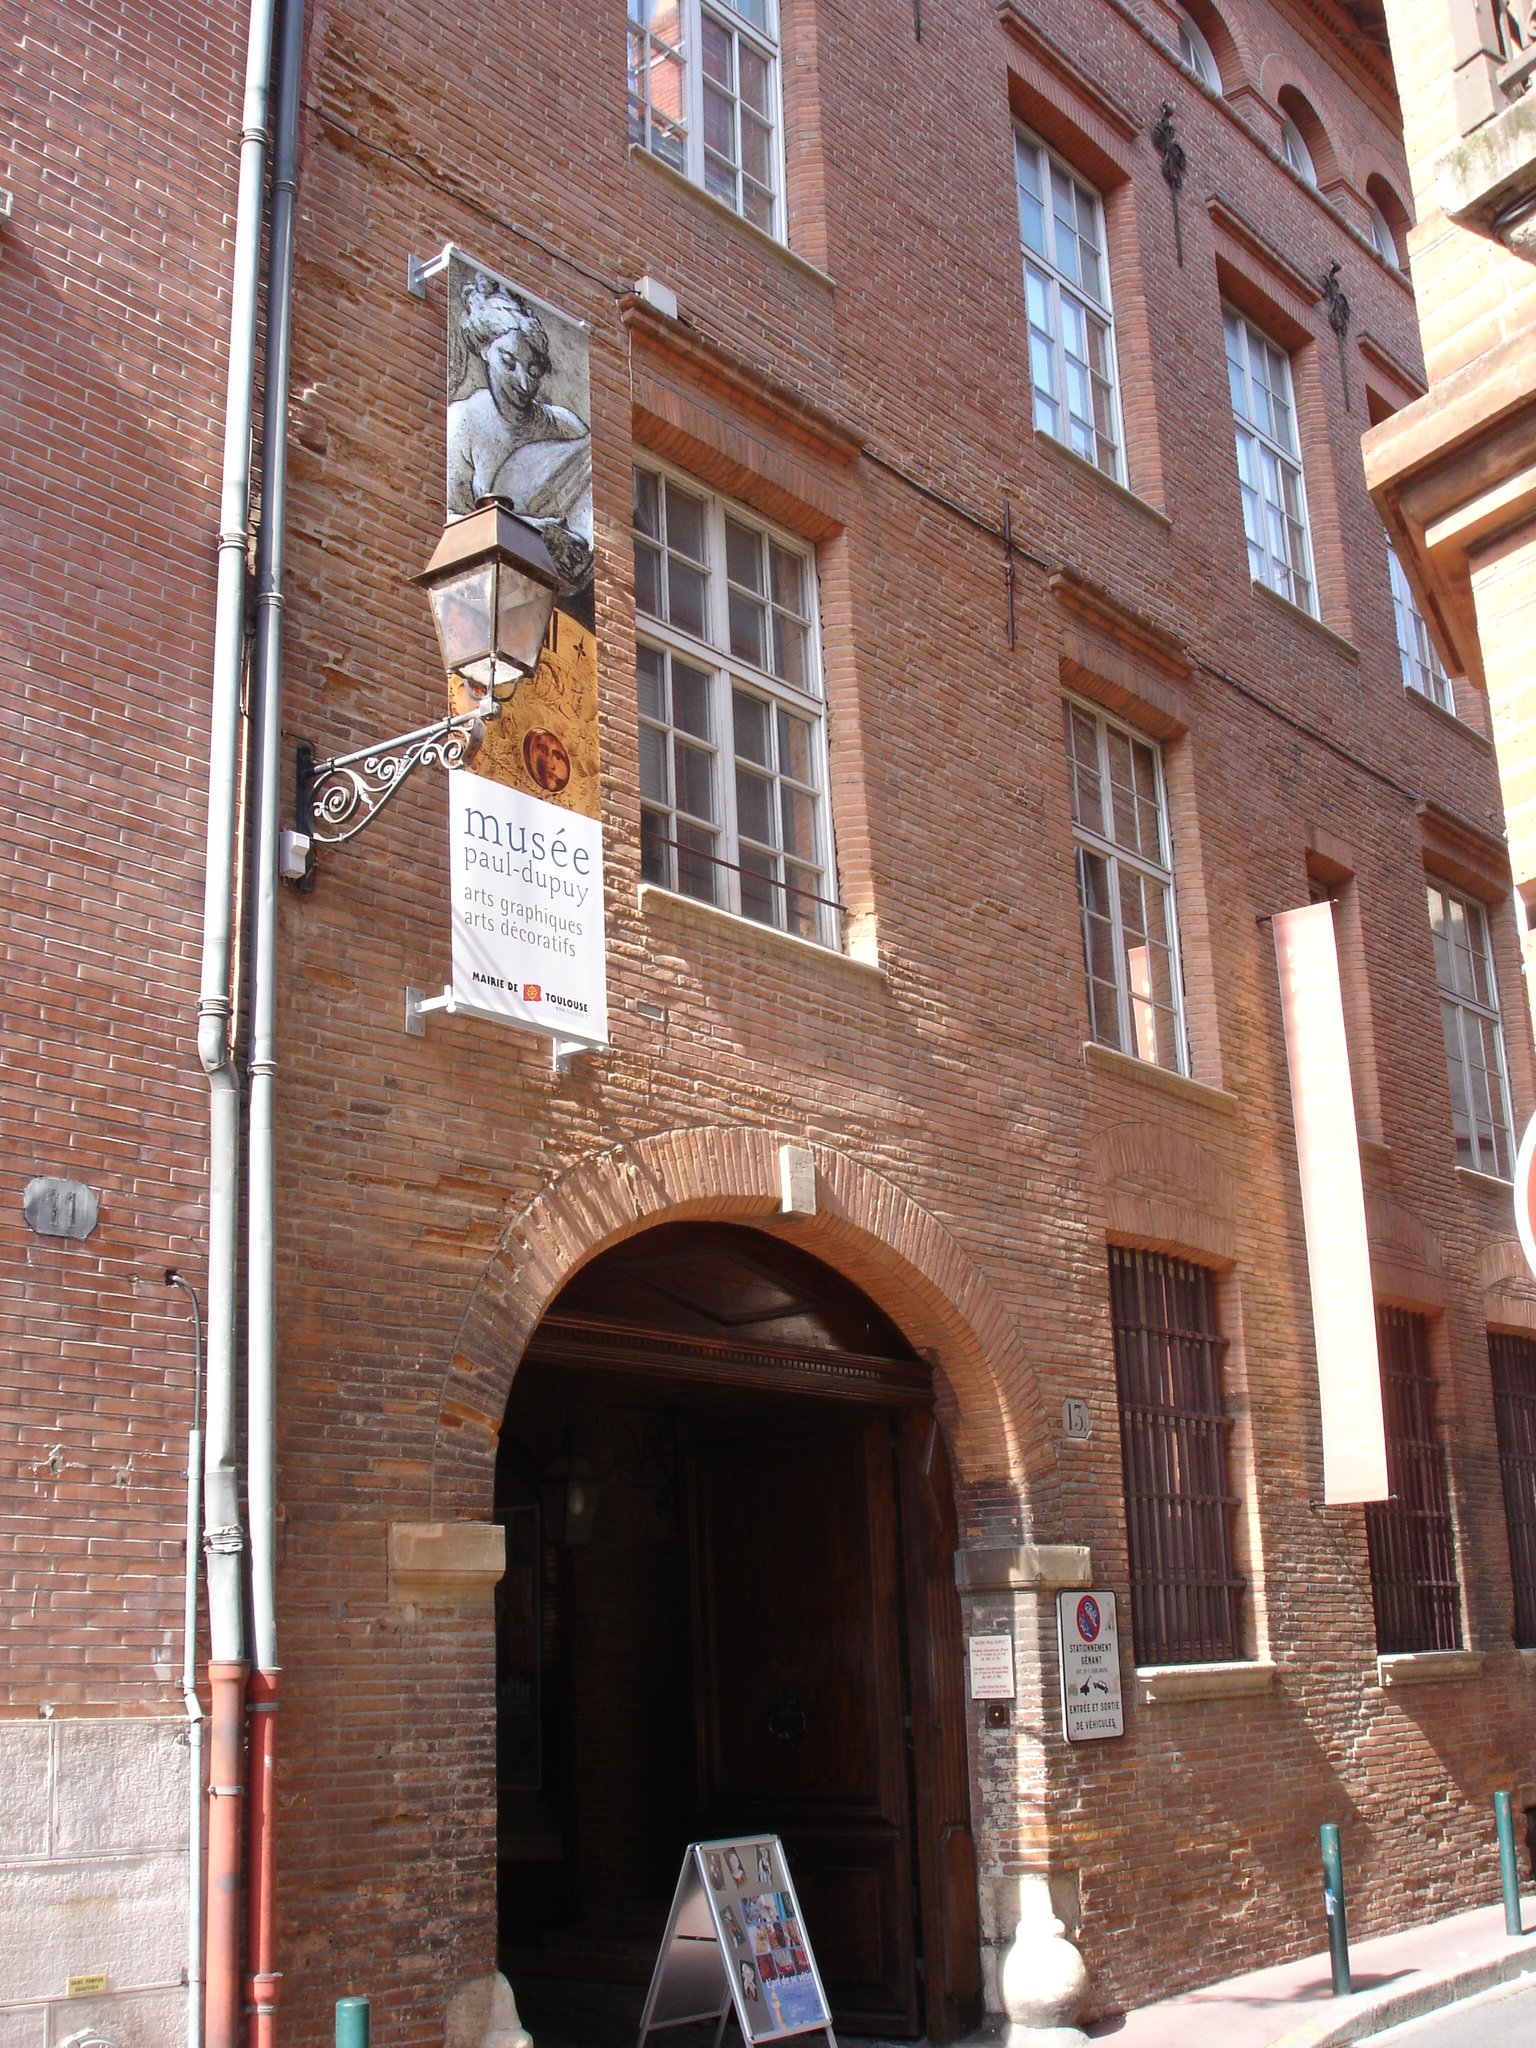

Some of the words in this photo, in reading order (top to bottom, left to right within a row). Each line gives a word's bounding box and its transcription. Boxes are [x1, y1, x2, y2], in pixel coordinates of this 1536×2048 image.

[464, 808, 590, 875] musée
[464, 846, 589, 907] paul-dupuy
[464, 886, 494, 907] arts
[500, 898, 583, 936] graphiques
[464, 911, 494, 932] arts
[500, 920, 576, 957] décoratifs
[472, 971, 504, 989] MAIRIE
[507, 981, 518, 993] DE
[545, 992, 588, 1013] TOULOUSE
[1069, 1643, 1112, 1653] STATIONNEMENT
[1081, 1654, 1102, 1665] GÊNANT
[1069, 1701, 1091, 1714] ENTRÉE
[1092, 1702, 1099, 1712] ET
[1100, 1701, 1120, 1711] SORTIE
[1076, 1721, 1084, 1731] DE
[1085, 1718, 1115, 1729] VÉHICULES
